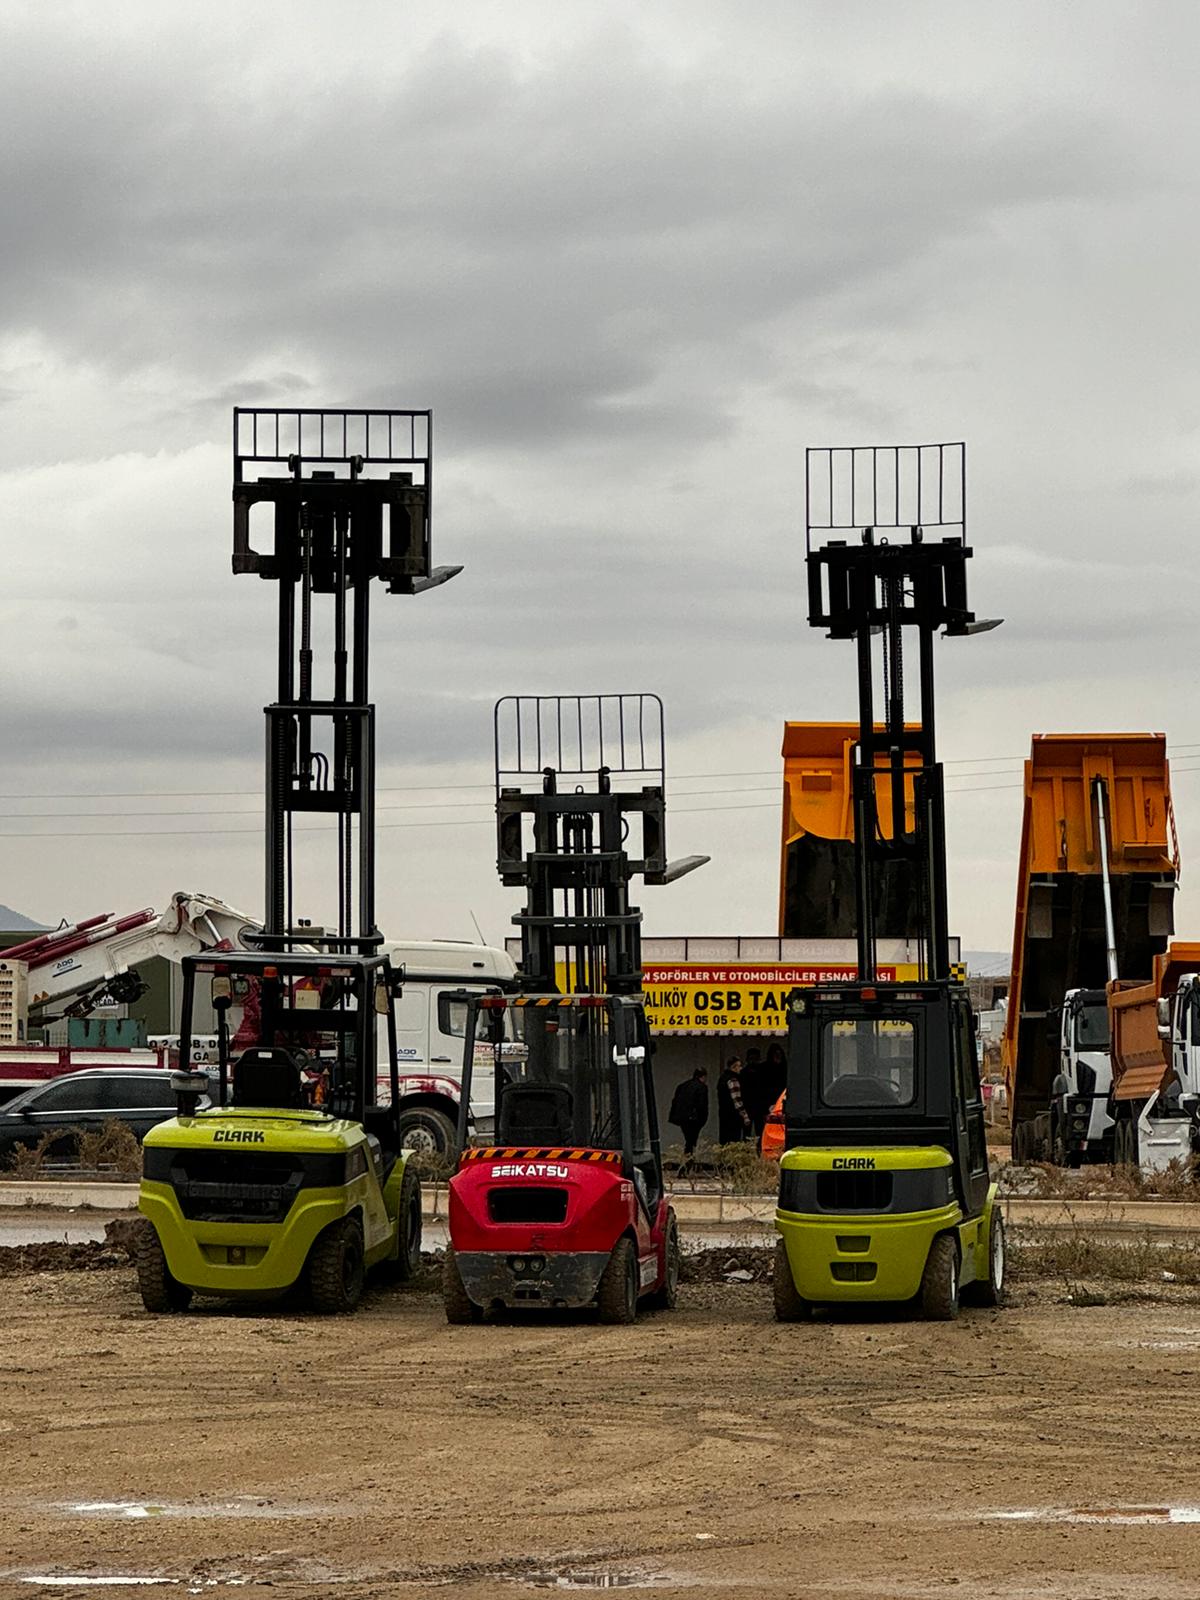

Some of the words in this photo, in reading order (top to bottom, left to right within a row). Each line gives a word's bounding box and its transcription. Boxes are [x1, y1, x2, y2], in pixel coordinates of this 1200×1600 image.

[653, 969, 710, 983] ŞOFÖRLER
[712, 971, 727, 981] VE
[729, 969, 817, 982] OTOMOBİLCİLER
[642, 987, 687, 1008] ALIKÖY
[693, 991, 742, 1011] OSB
[668, 1015, 691, 1026] 621
[694, 1015, 709, 1025] 05
[713, 1015, 728, 1025] 05
[740, 1015, 762, 1026] 621
[766, 1015, 780, 1026] 11
[213, 1130, 265, 1144] CLARK
[832, 1157, 876, 1169] CLARK
